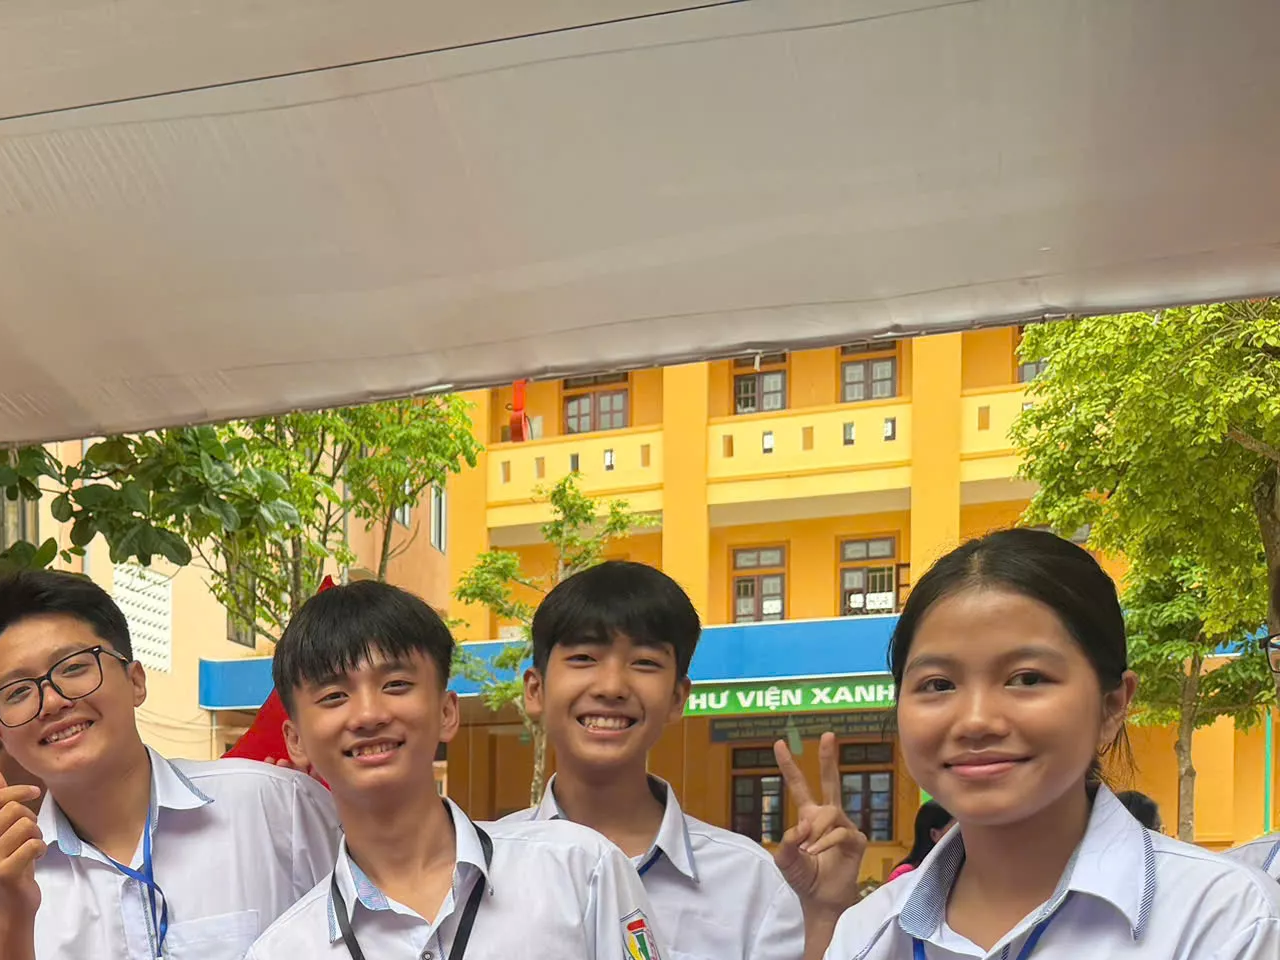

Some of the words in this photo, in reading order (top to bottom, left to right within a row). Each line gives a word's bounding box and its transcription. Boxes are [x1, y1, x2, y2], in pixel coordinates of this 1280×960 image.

[687, 690, 730, 711] HƯ
[736, 685, 802, 711] VIỆN
[811, 684, 895, 705] XANH
